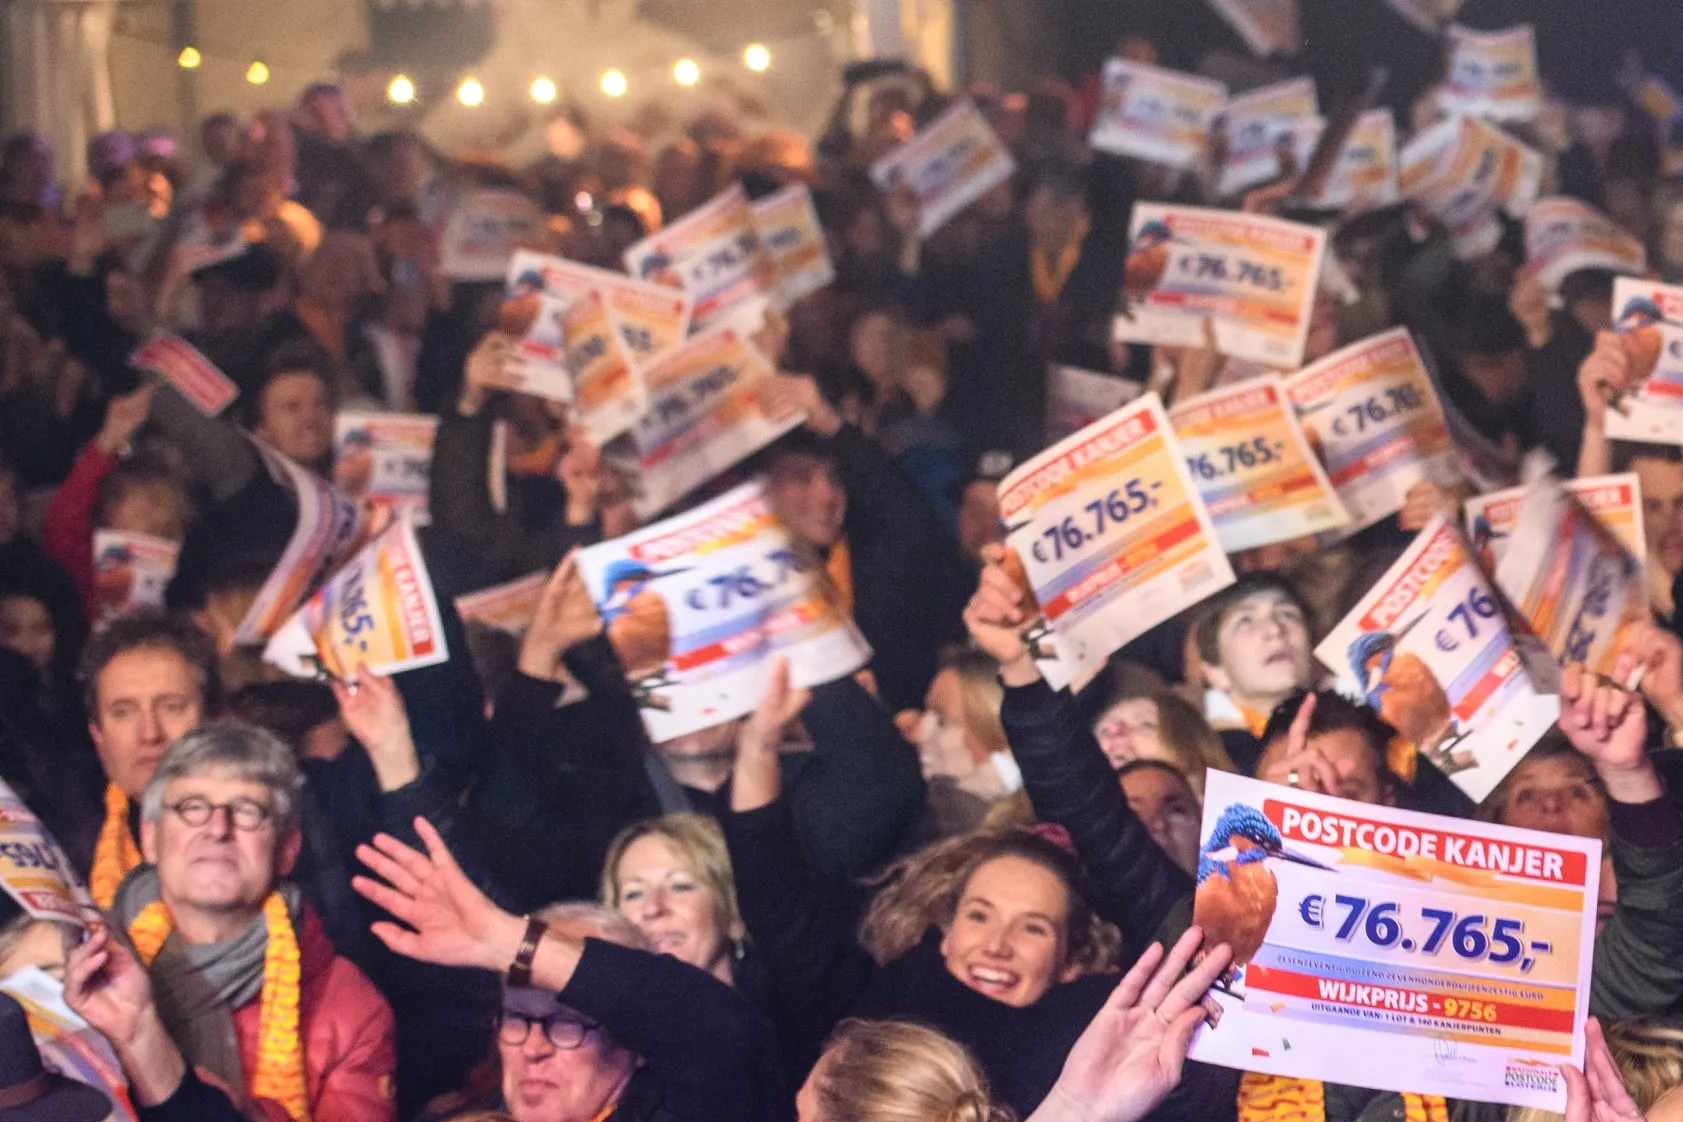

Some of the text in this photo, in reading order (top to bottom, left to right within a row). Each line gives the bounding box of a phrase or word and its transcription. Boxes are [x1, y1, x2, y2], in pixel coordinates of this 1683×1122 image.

[1282, 808, 1564, 881] POSTCODE KANJER
[1298, 894, 1324, 929] €
[1311, 1002, 1361, 1017] UITGAANDE
[1391, 1013, 1407, 1023] LOT
[1432, 1018, 1501, 1036] KANJERPUNTEN
[1318, 979, 1430, 1013] WIJKPRIJS
[1443, 999, 1498, 1021] 9756
